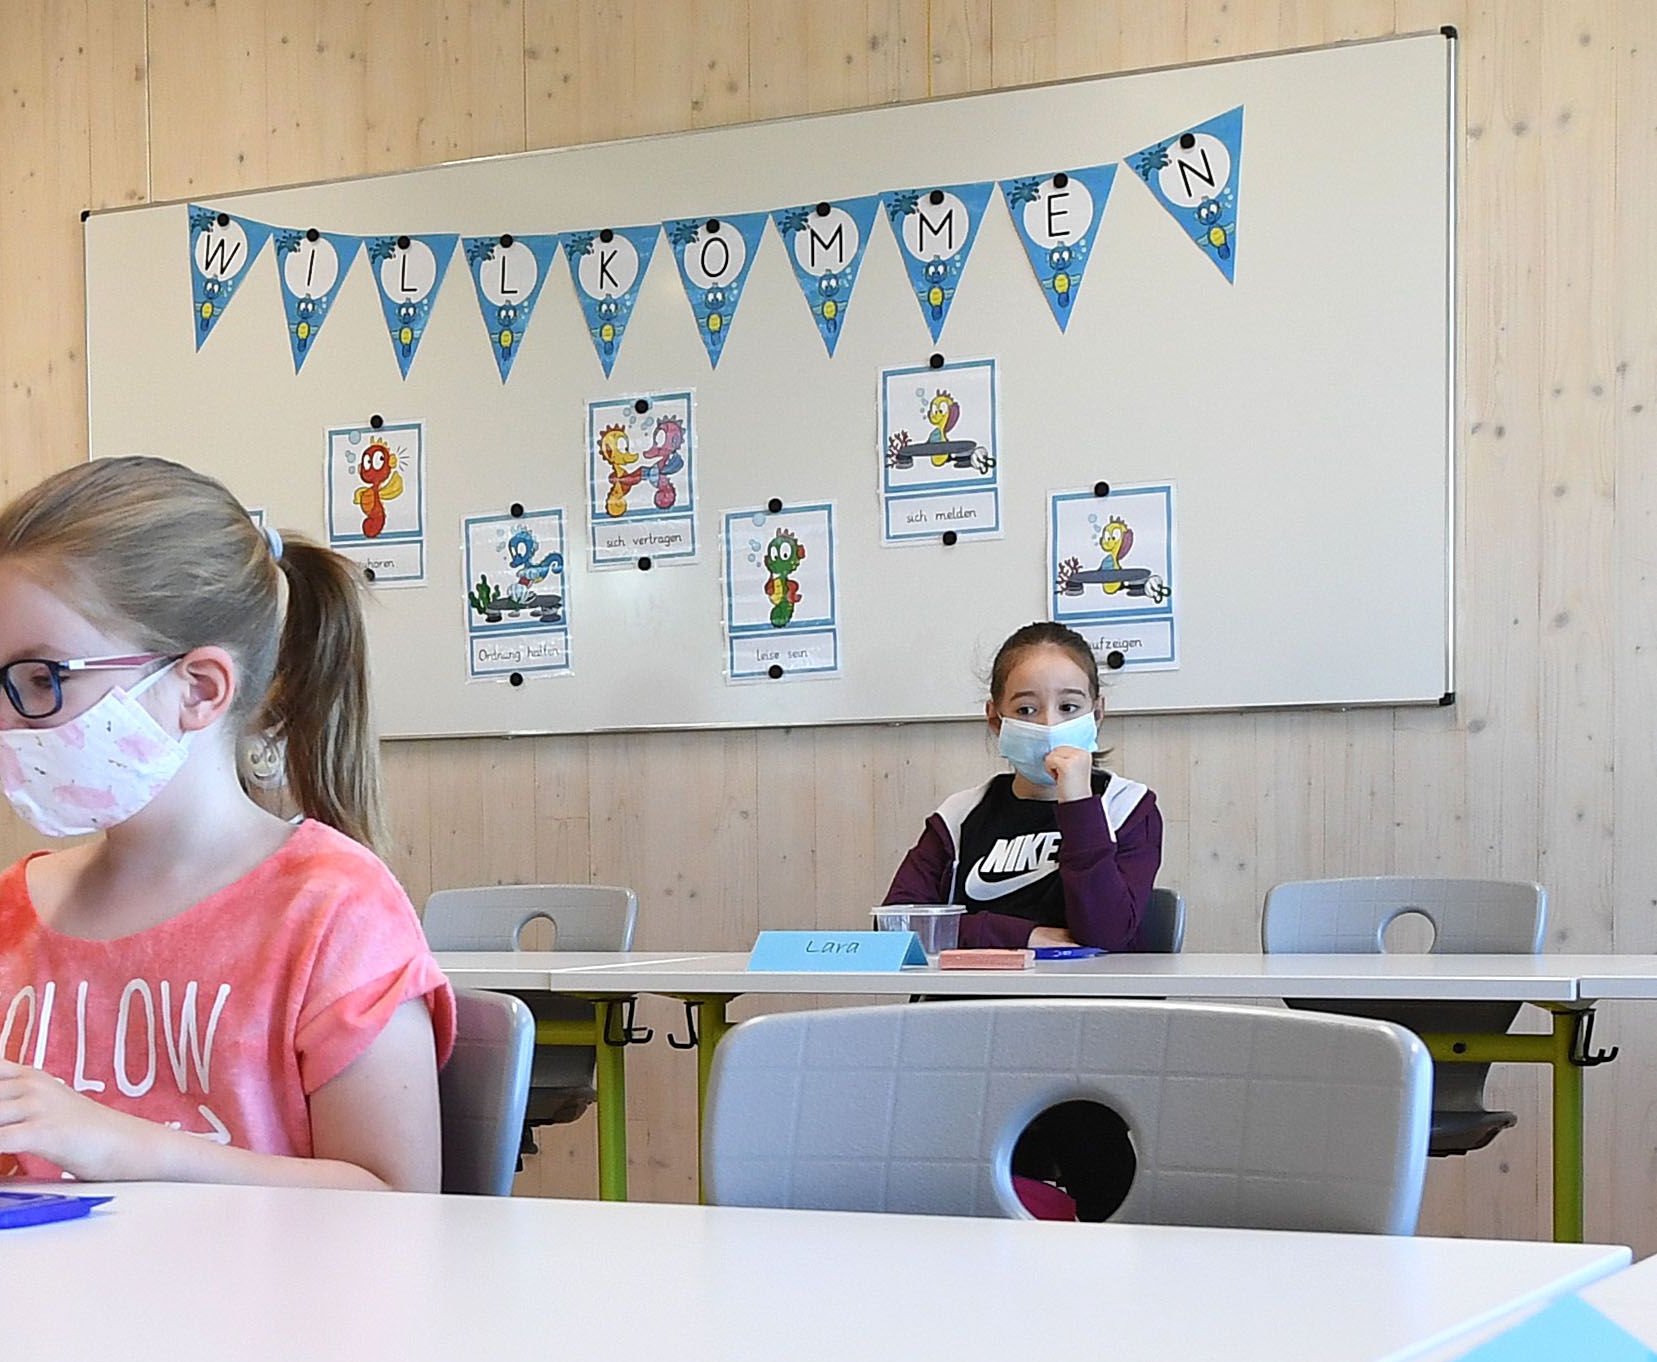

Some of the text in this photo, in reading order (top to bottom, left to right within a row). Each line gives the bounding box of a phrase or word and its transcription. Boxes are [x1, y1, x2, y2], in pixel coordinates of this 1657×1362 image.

[202, 149, 1215, 296] WILLKOMMEN
[905, 507, 977, 524] sich melden
[606, 532, 682, 548] sich vertragen
[1089, 636, 1142, 652] ufzeigen
[479, 648, 522, 664] Ordnung
[756, 648, 780, 662] leise
[980, 831, 1063, 874] NIKE
[805, 938, 859, 954] Lara
